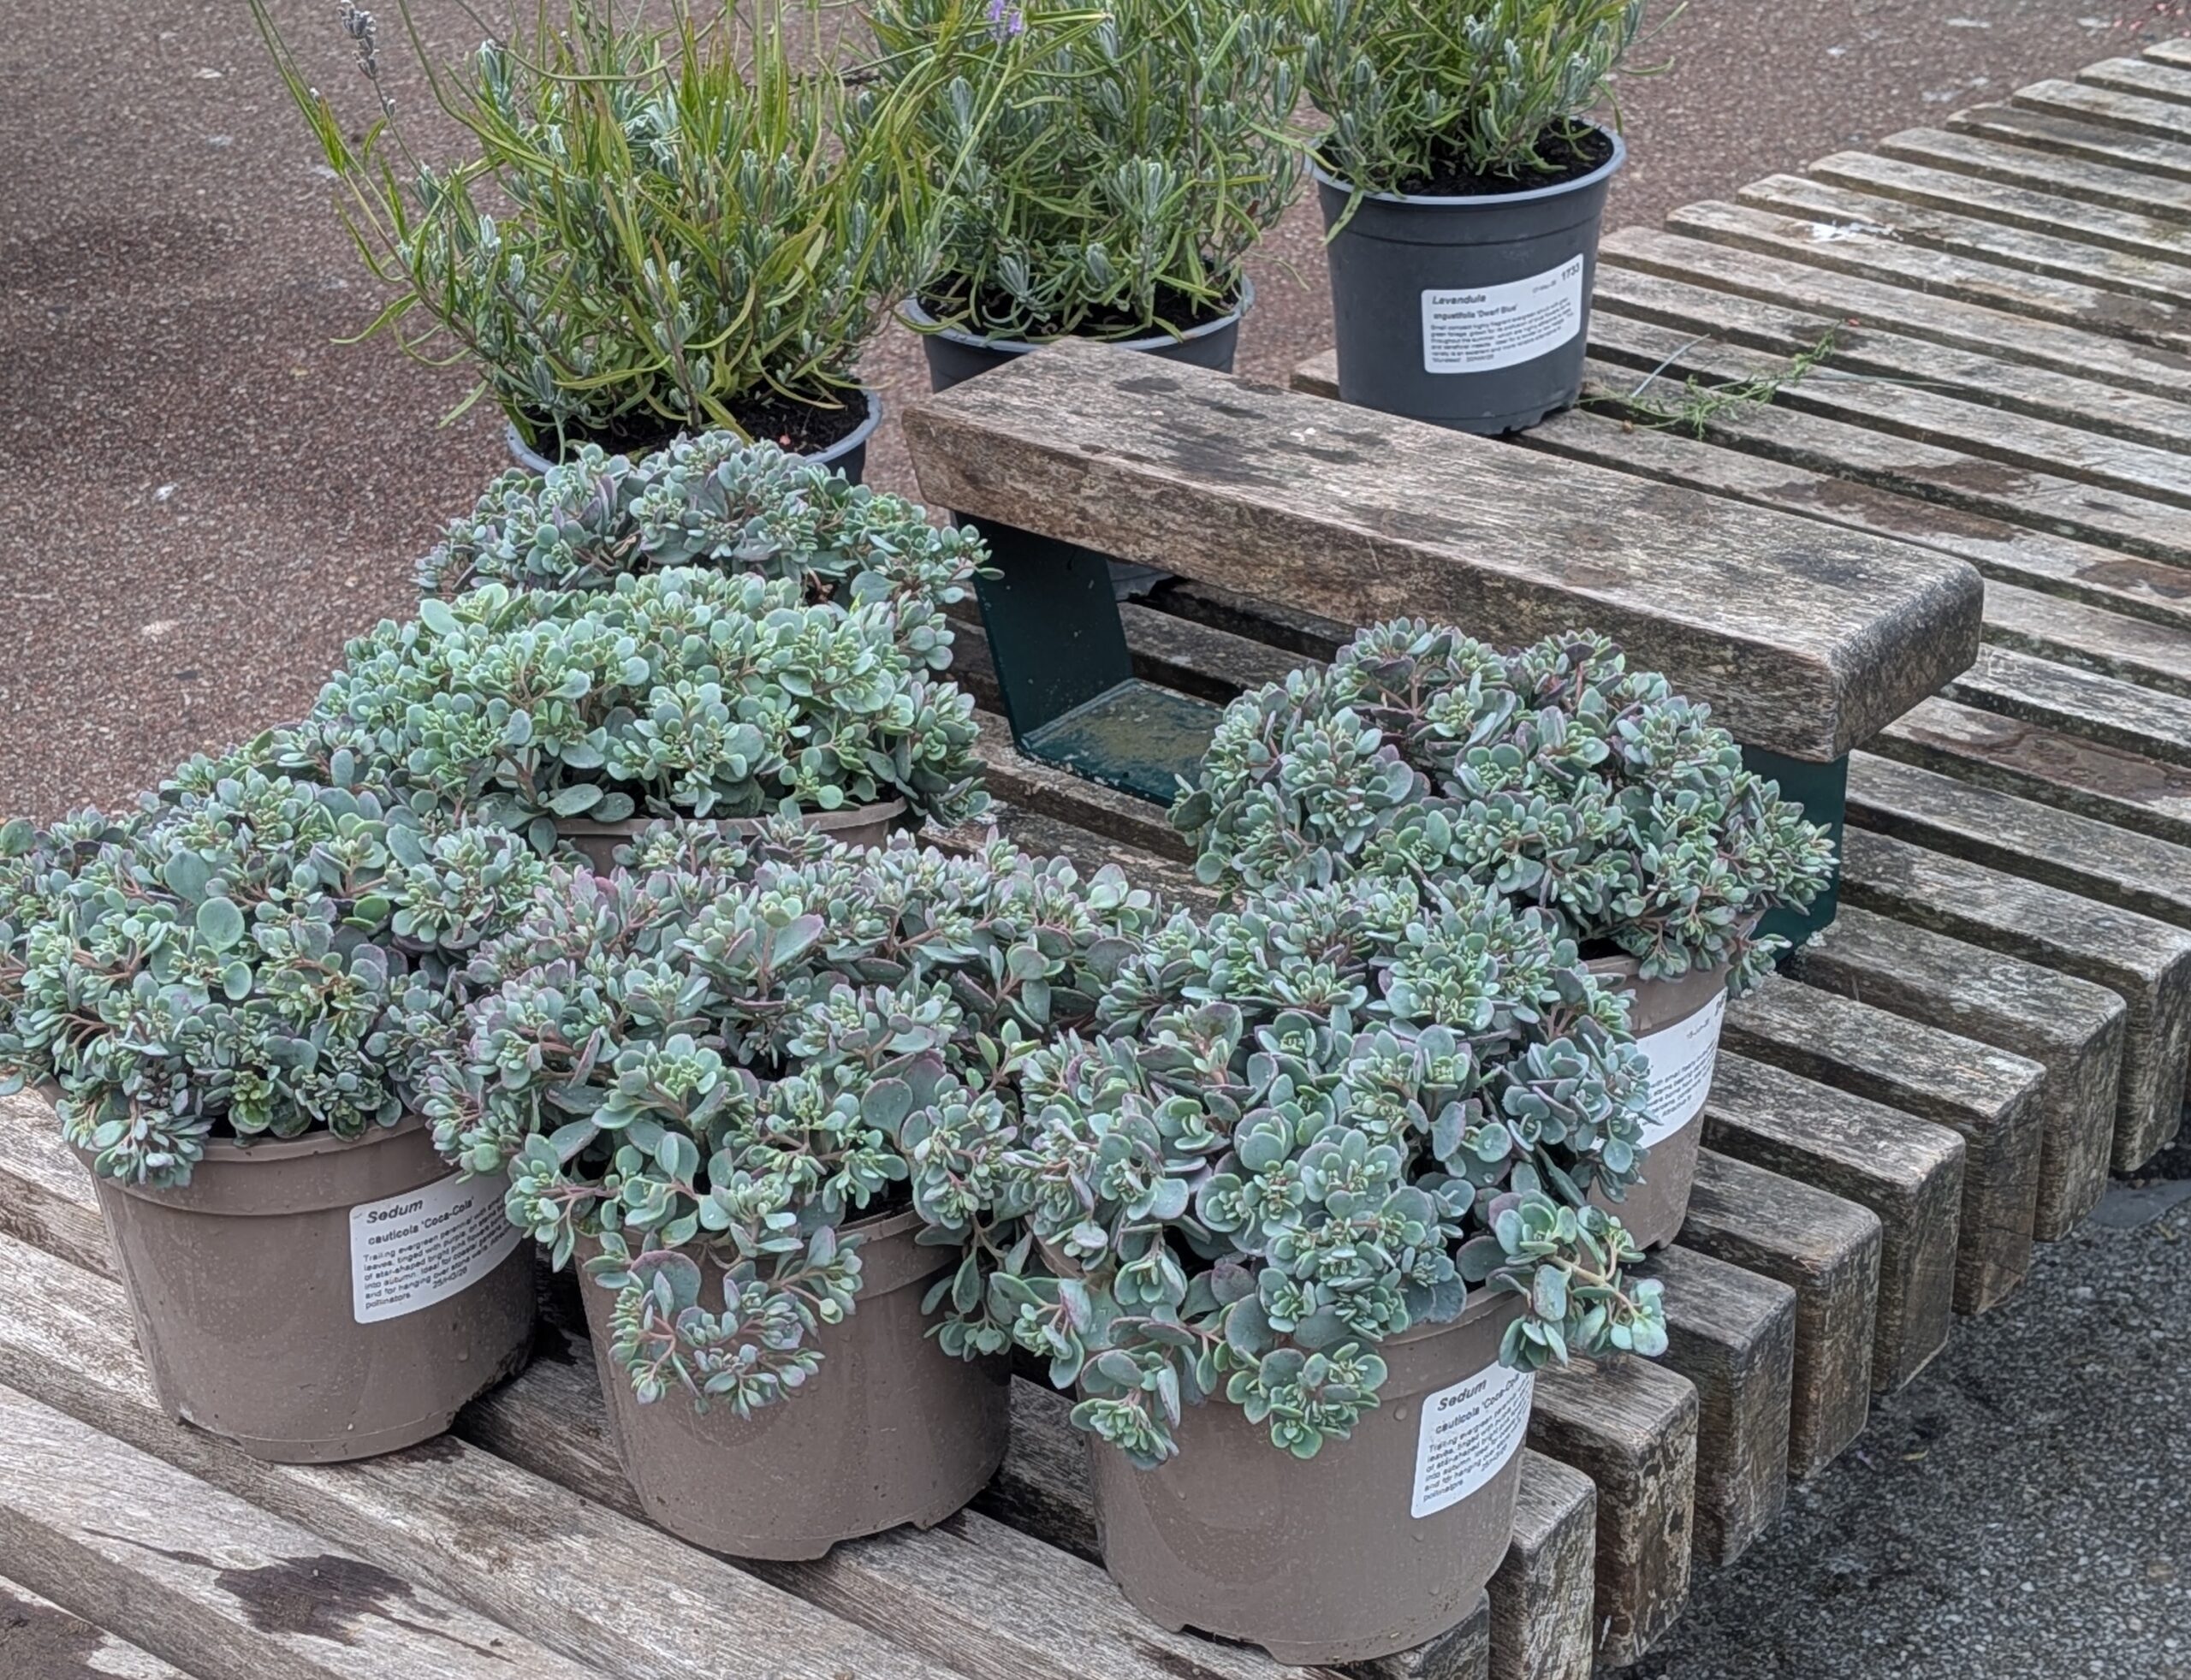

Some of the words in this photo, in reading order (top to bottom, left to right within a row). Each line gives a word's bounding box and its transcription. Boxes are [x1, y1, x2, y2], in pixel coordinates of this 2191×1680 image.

[1432, 294, 1487, 305] Lavandula
[366, 1200, 423, 1224] Sedum
[368, 1225, 419, 1245] cauticola
[421, 1196, 473, 1228] 'Coca-Cola'
[1438, 1379, 1487, 1411] Sedum
